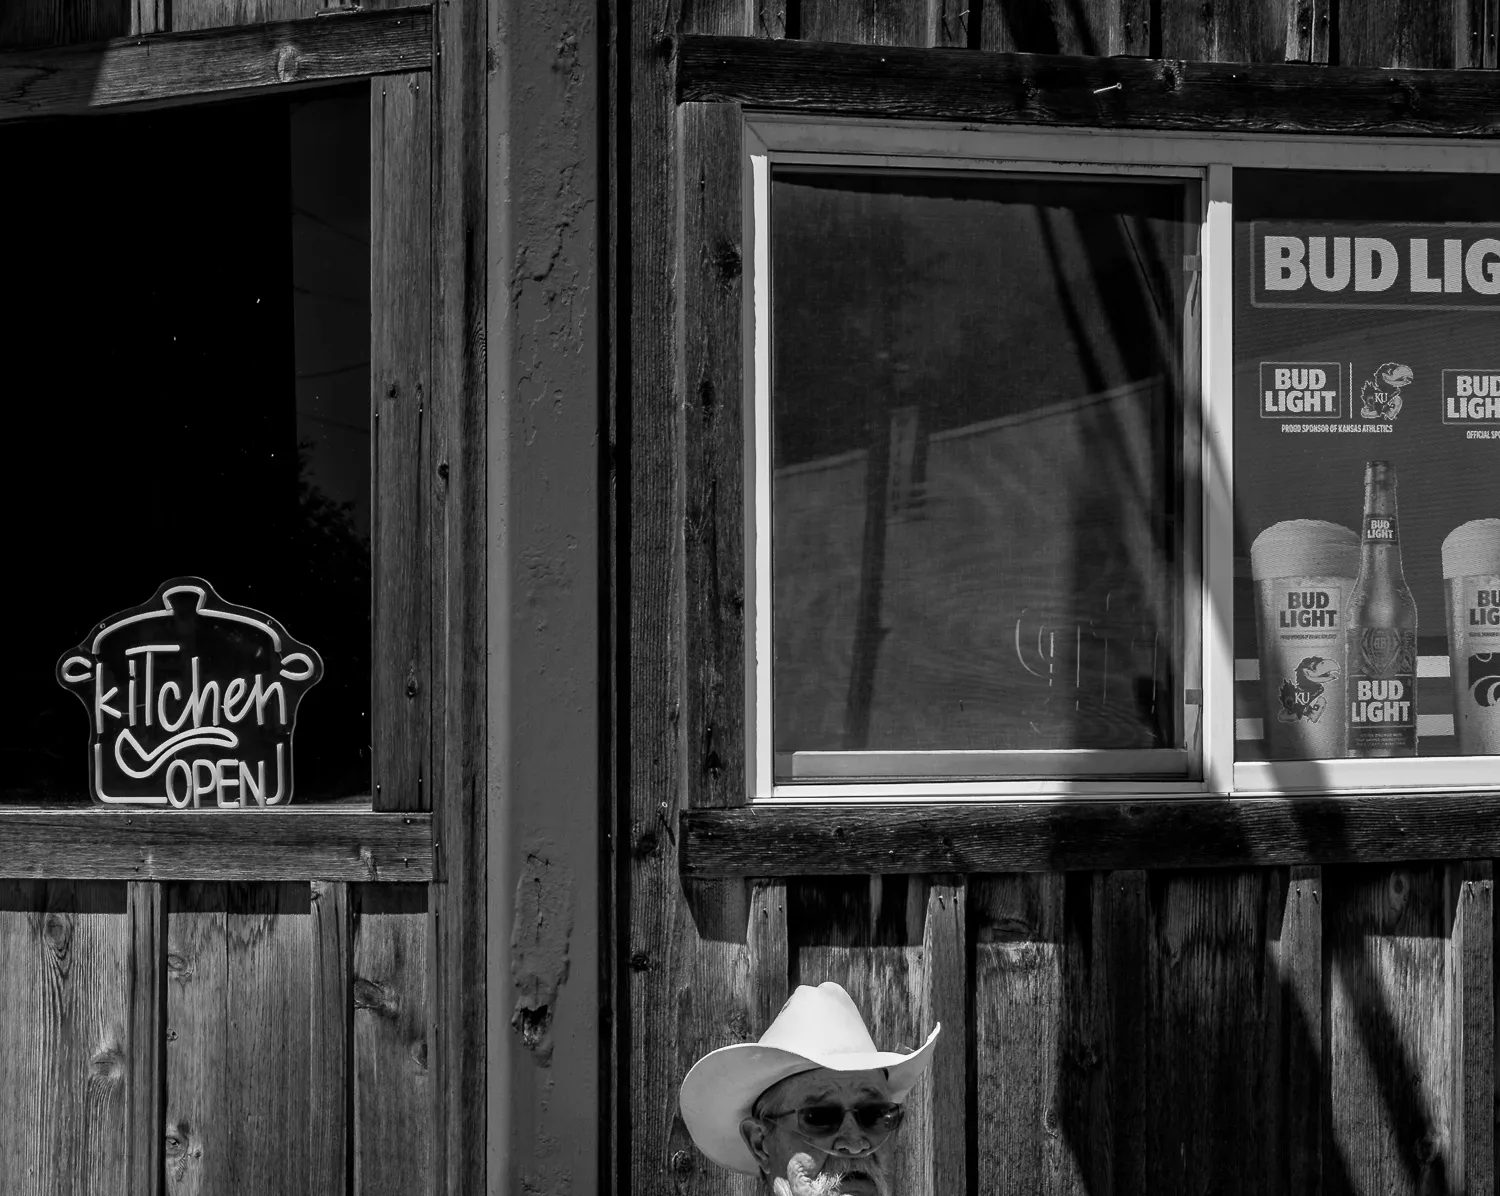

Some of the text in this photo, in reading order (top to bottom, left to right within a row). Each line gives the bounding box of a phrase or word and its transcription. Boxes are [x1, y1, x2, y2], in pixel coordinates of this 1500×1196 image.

[1264, 235, 1399, 292] BUD
[1275, 368, 1326, 390] BUD
[1265, 390, 1337, 412] LIGHT
[1281, 424, 1393, 433] PROUD SPONSOR OF KANSAS ATHLETICS
[1466, 430, 1491, 439] OFFICIAL
[1367, 529, 1394, 539] LIGHT
[1371, 519, 1390, 530] BUD
[1287, 591, 1330, 609] BUD
[1279, 609, 1337, 628] LIGHT
[1357, 679, 1404, 701] BUD
[1351, 701, 1411, 723] LIGHT
[165, 759, 266, 809] OPEN
